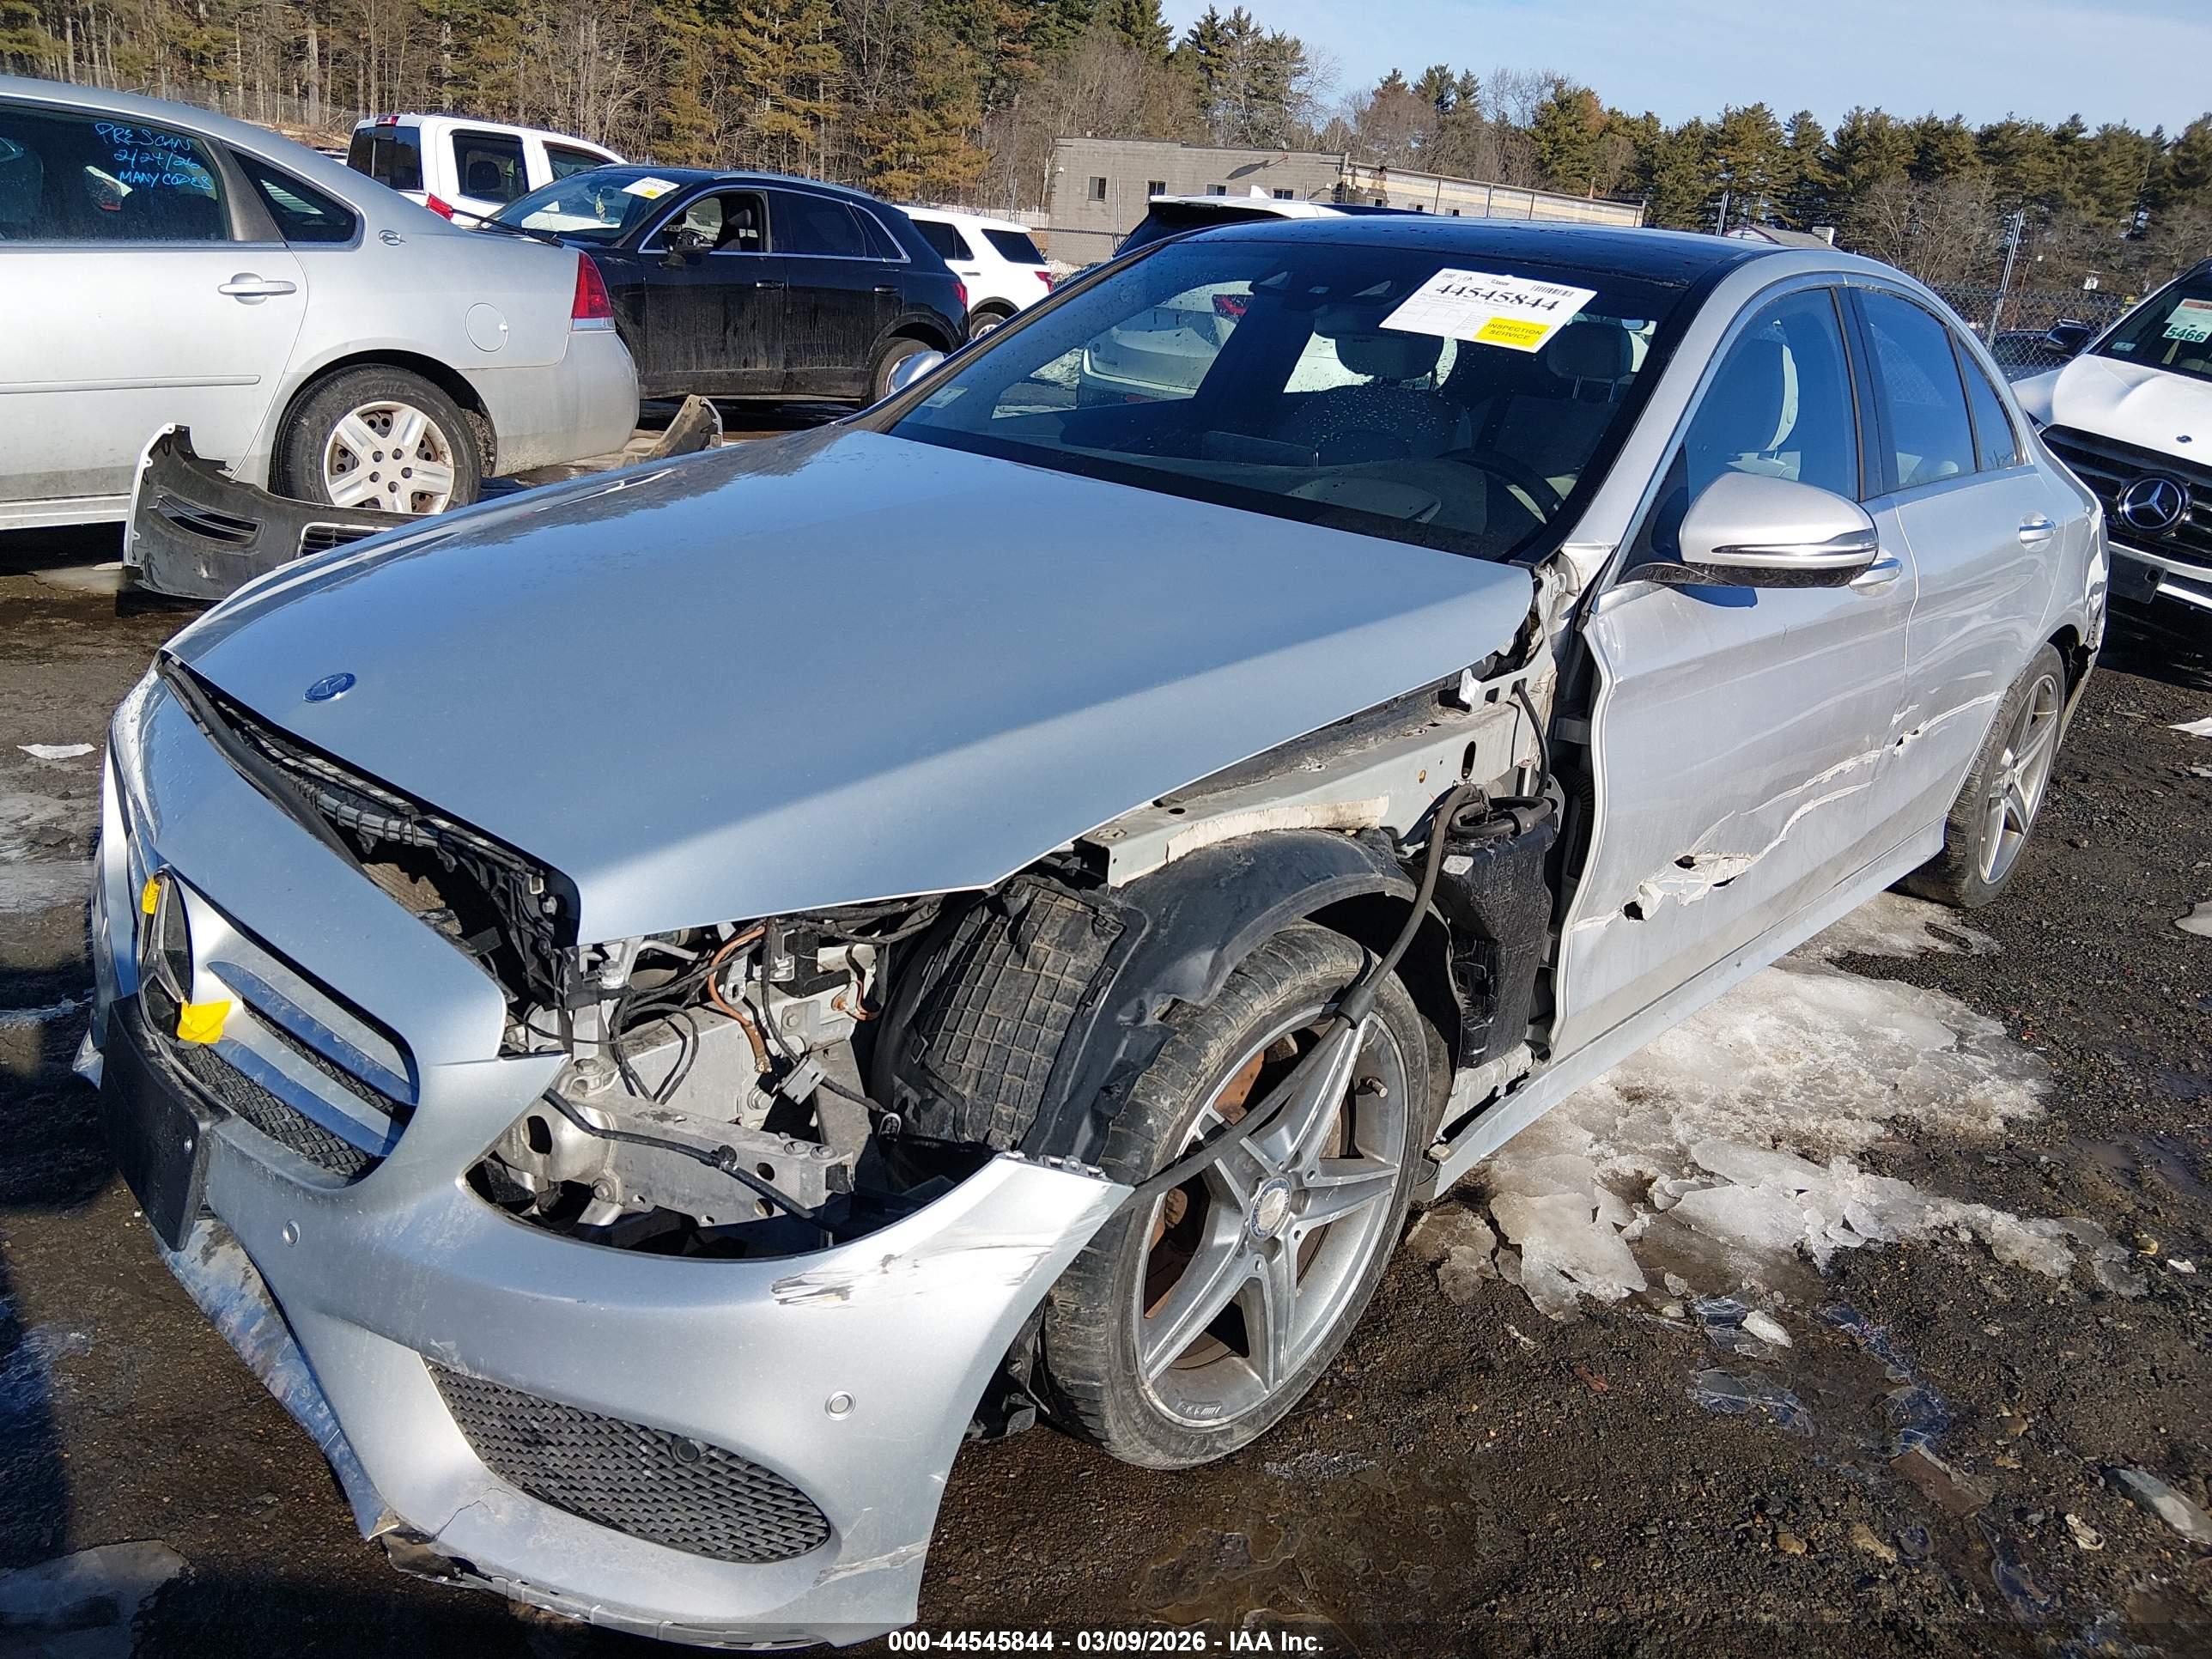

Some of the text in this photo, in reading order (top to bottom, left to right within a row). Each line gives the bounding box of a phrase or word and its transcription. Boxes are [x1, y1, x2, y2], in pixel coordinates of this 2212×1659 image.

[119, 171, 213, 190] MANY CODES
[1435, 283, 1560, 311] 44545844
[1487, 321, 1544, 336] INSPECTION
[1489, 329, 1530, 340] SERVICE
[2165, 326, 2207, 342] 5466
